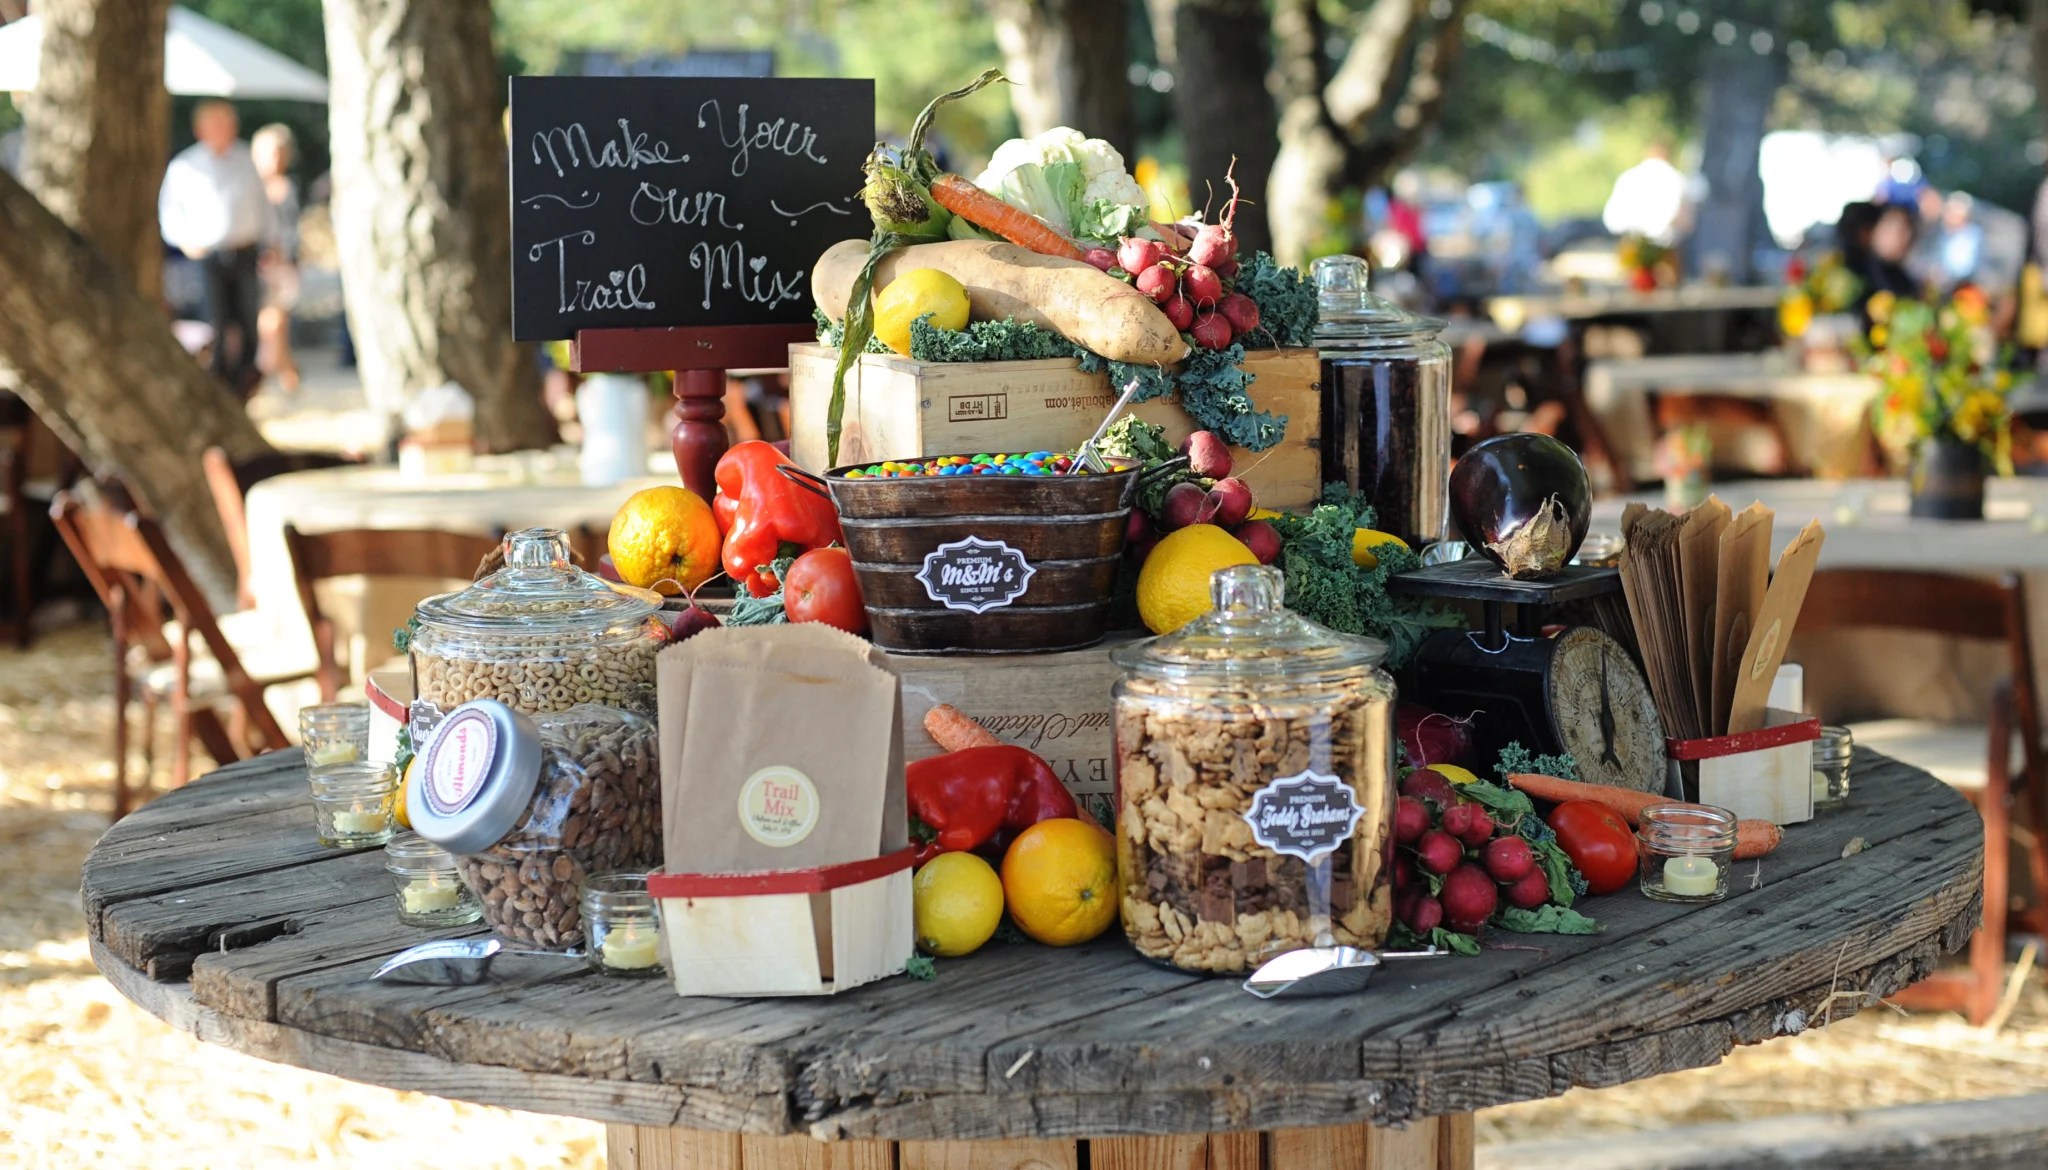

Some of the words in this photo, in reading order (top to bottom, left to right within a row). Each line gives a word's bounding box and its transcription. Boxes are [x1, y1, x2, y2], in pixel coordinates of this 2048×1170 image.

[533, 118, 690, 177] Make
[698, 99, 827, 177] Your
[630, 182, 743, 230] Own
[529, 230, 655, 313] Trail
[690, 240, 803, 310] Mix
[941, 561, 1014, 586] M&M's
[453, 727, 468, 798] Almonds
[762, 780, 799, 800] Trail
[764, 799, 794, 816] Mix
[1261, 805, 1299, 833] Teddy
[1300, 803, 1350, 828] Grahams
